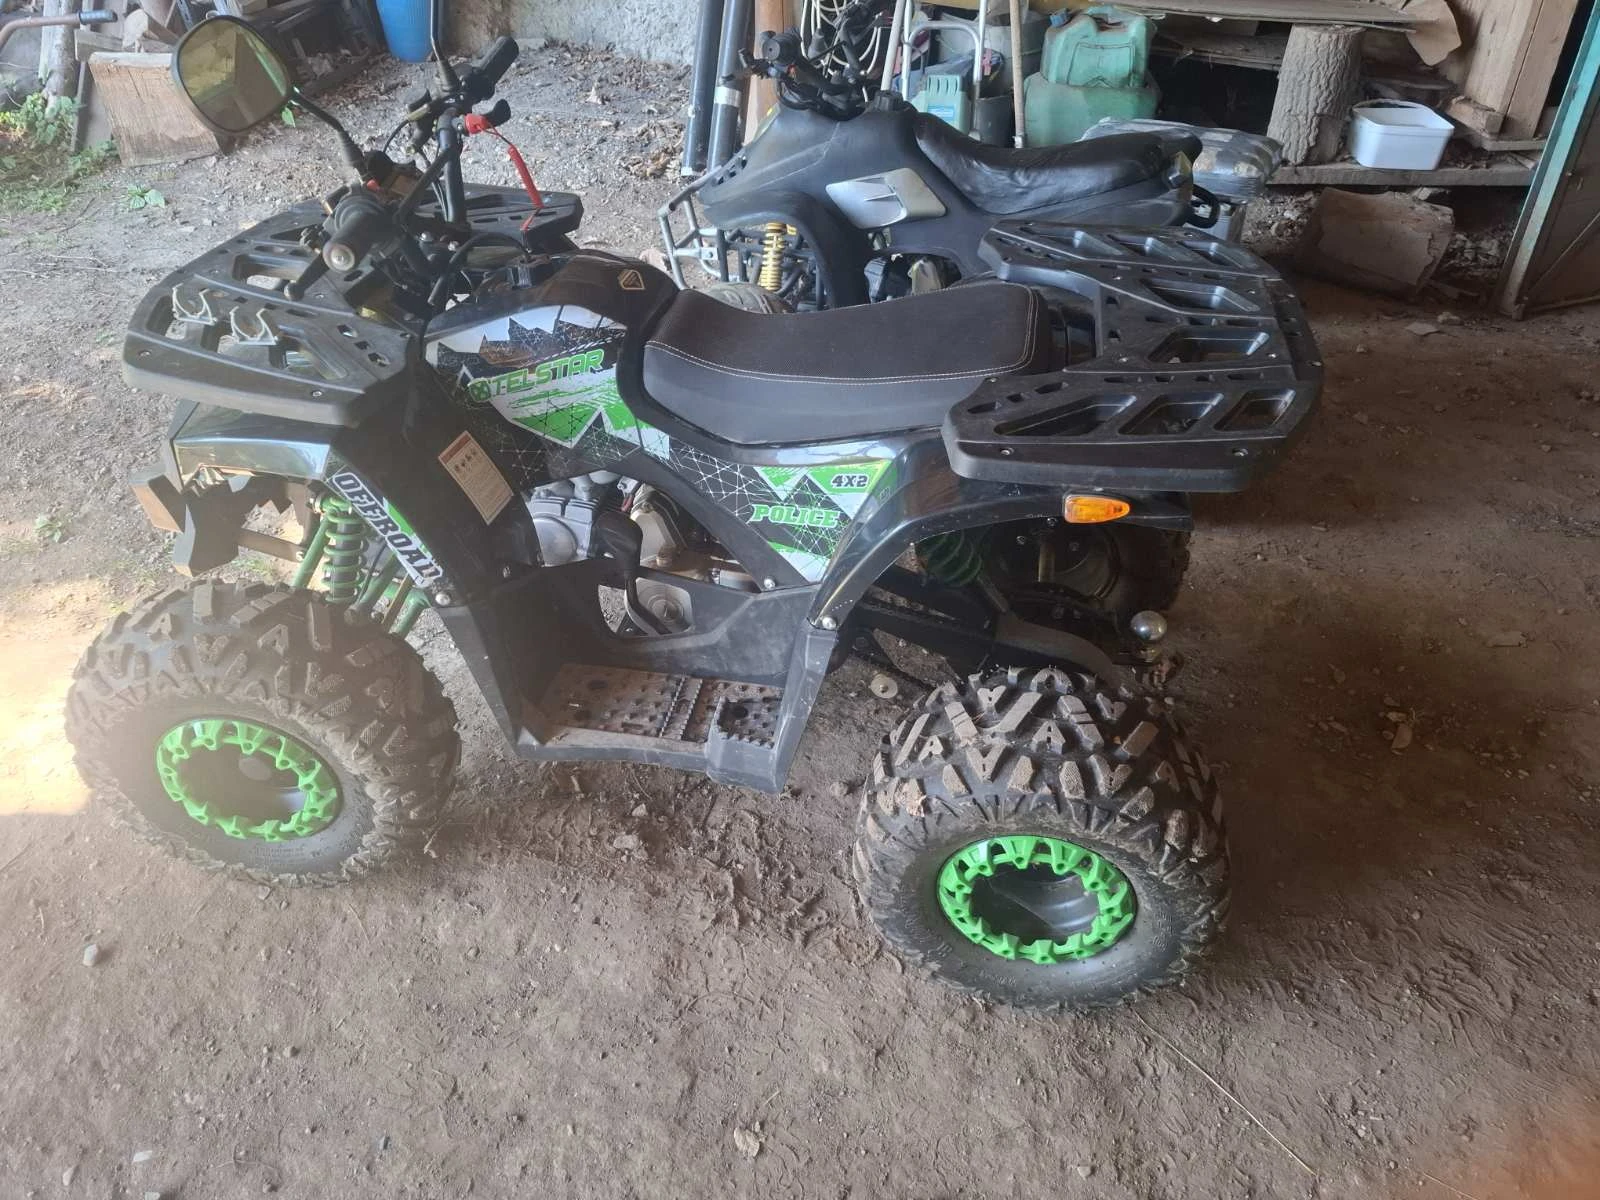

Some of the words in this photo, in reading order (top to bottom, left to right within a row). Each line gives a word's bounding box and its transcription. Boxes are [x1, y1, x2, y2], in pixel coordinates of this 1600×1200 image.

[492, 349, 605, 396] TELSTAR
[830, 473, 869, 489] 4X2
[333, 472, 443, 586] OFFROAD
[750, 504, 841, 527] POLICE
